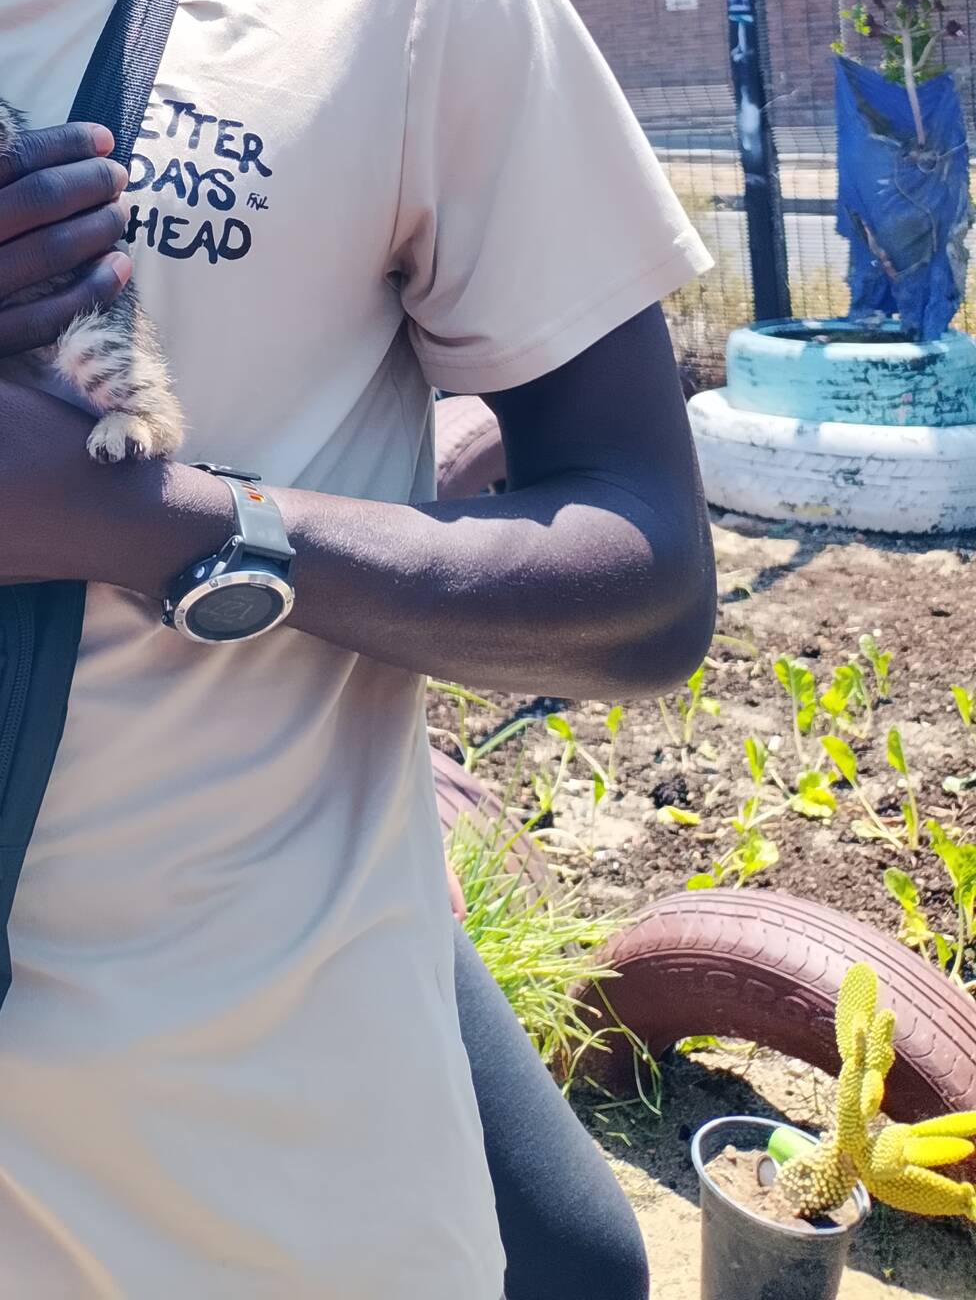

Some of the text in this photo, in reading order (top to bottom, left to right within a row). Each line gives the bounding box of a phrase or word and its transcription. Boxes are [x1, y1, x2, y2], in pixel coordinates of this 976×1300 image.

[137, 99, 273, 177] ETTER
[123, 153, 237, 211] DAYS
[122, 204, 252, 264] HEAD
